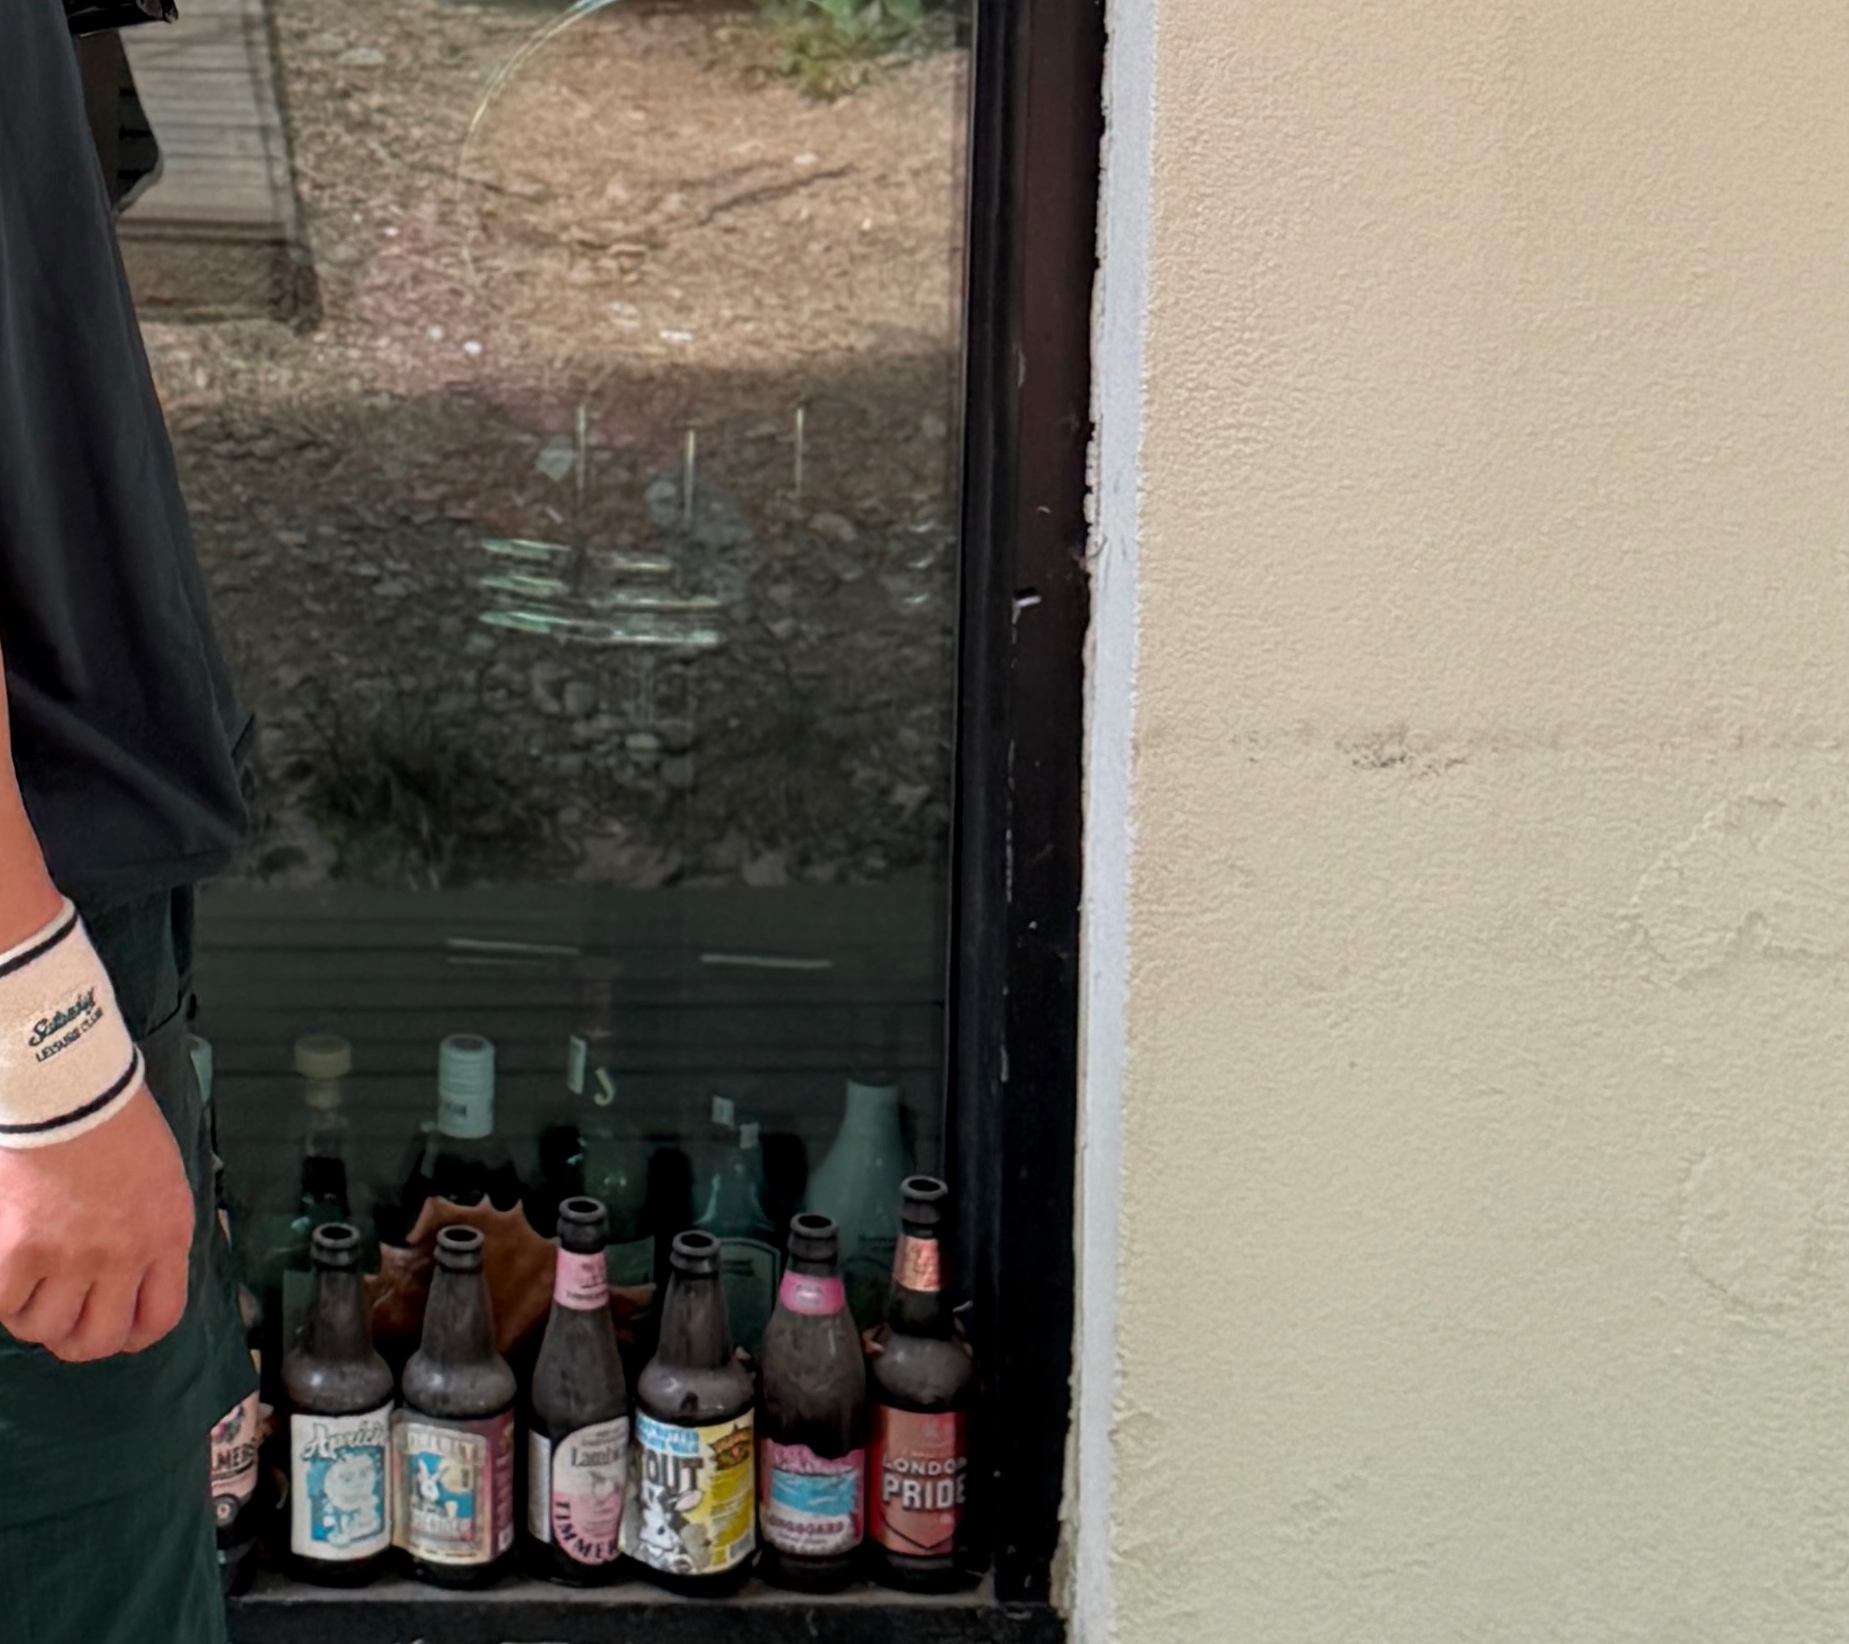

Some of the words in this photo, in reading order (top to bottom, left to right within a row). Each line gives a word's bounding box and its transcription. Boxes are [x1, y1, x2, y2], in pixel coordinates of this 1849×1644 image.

[36, 1027, 81, 1062] LEISURE
[80, 1006, 103, 1033] CLUB
[882, 1471, 966, 1510] PRIDE
